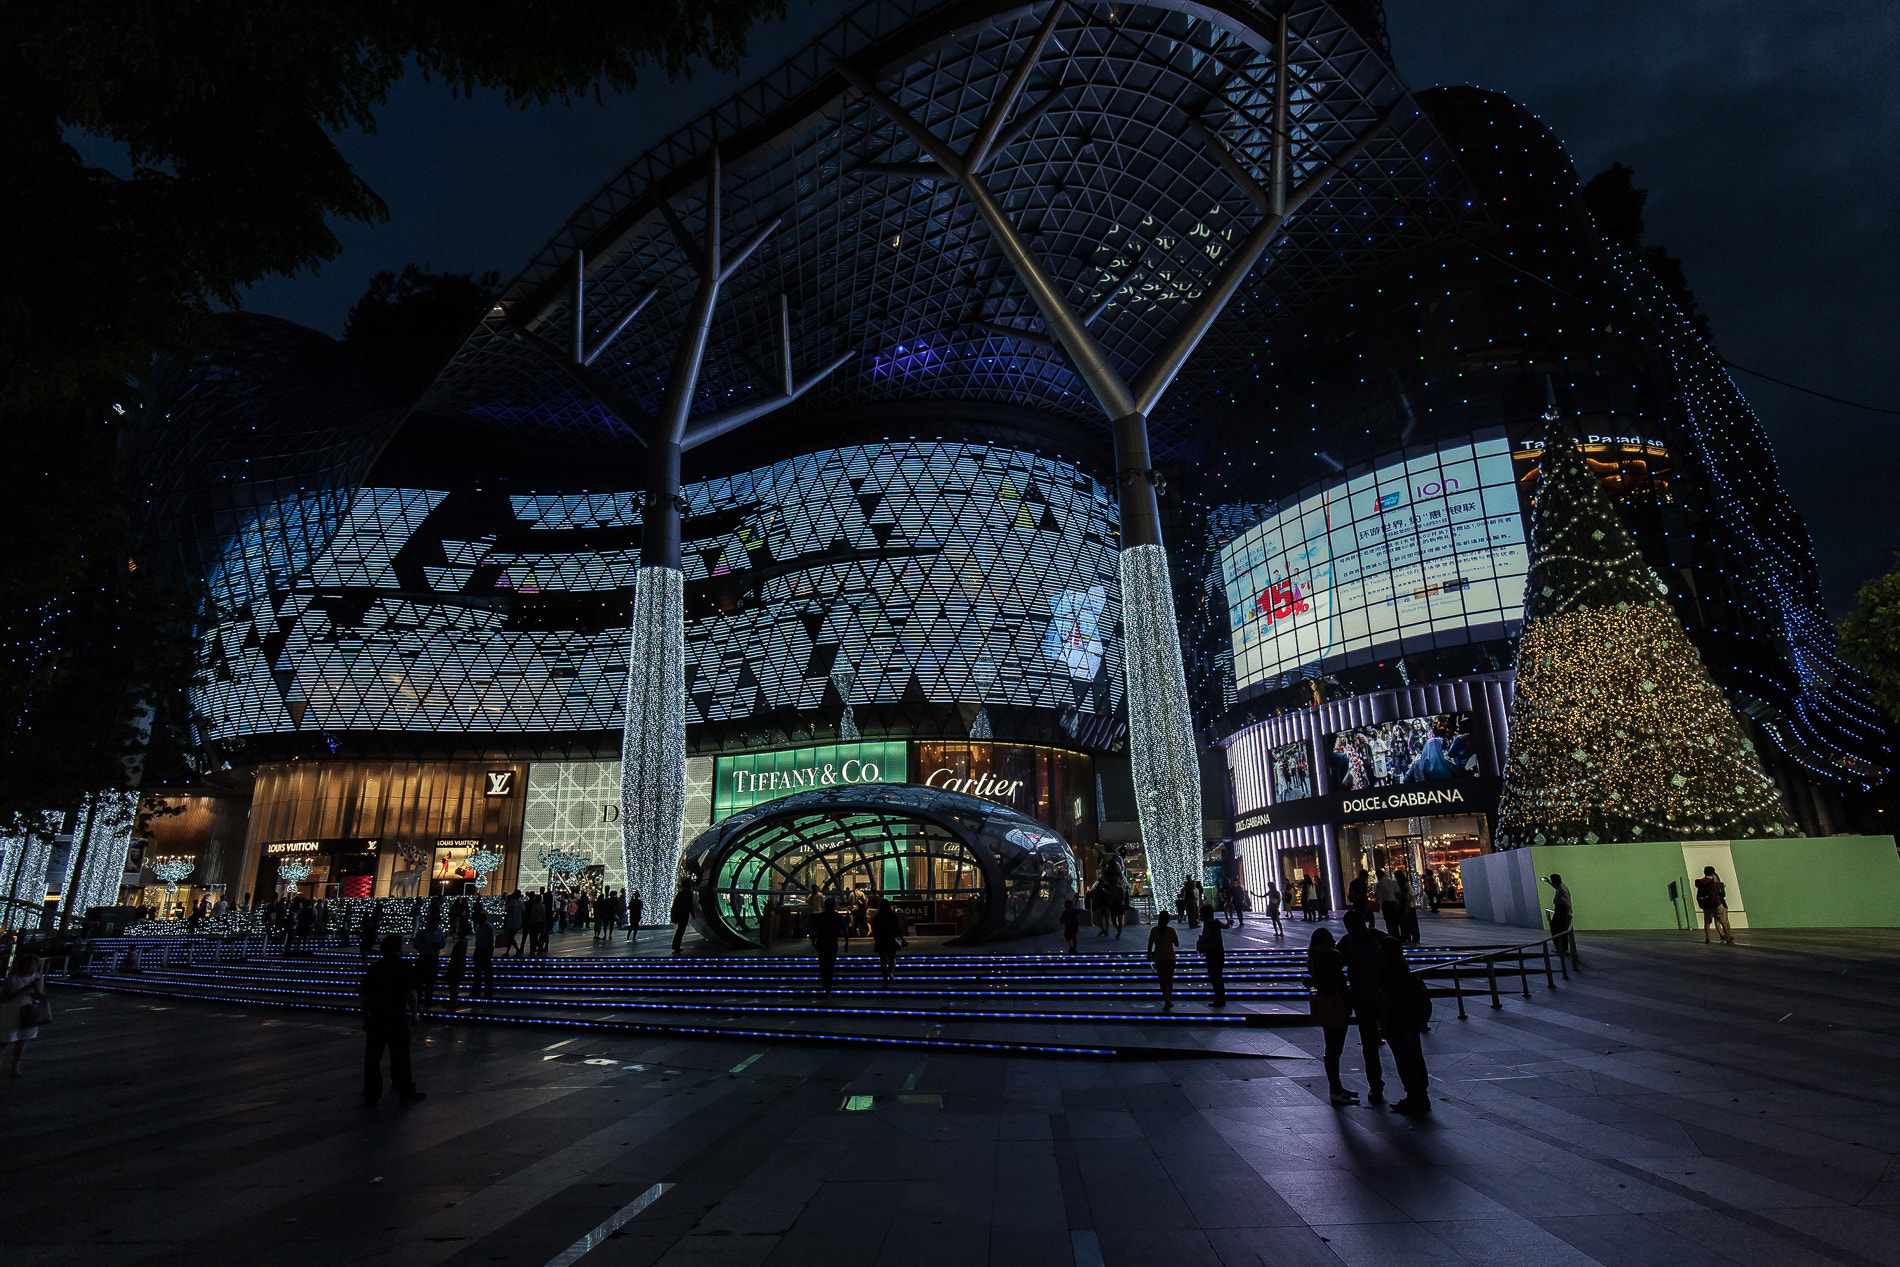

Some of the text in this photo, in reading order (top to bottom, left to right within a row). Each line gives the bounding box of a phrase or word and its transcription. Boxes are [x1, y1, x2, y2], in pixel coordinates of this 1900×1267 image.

[1520, 435, 1664, 450] Tae Paadse
[732, 767, 820, 793] TIFFANY
[820, 763, 838, 785] &
[925, 768, 1024, 797] Cartier
[268, 842, 319, 853] LOUIS VUITTON
